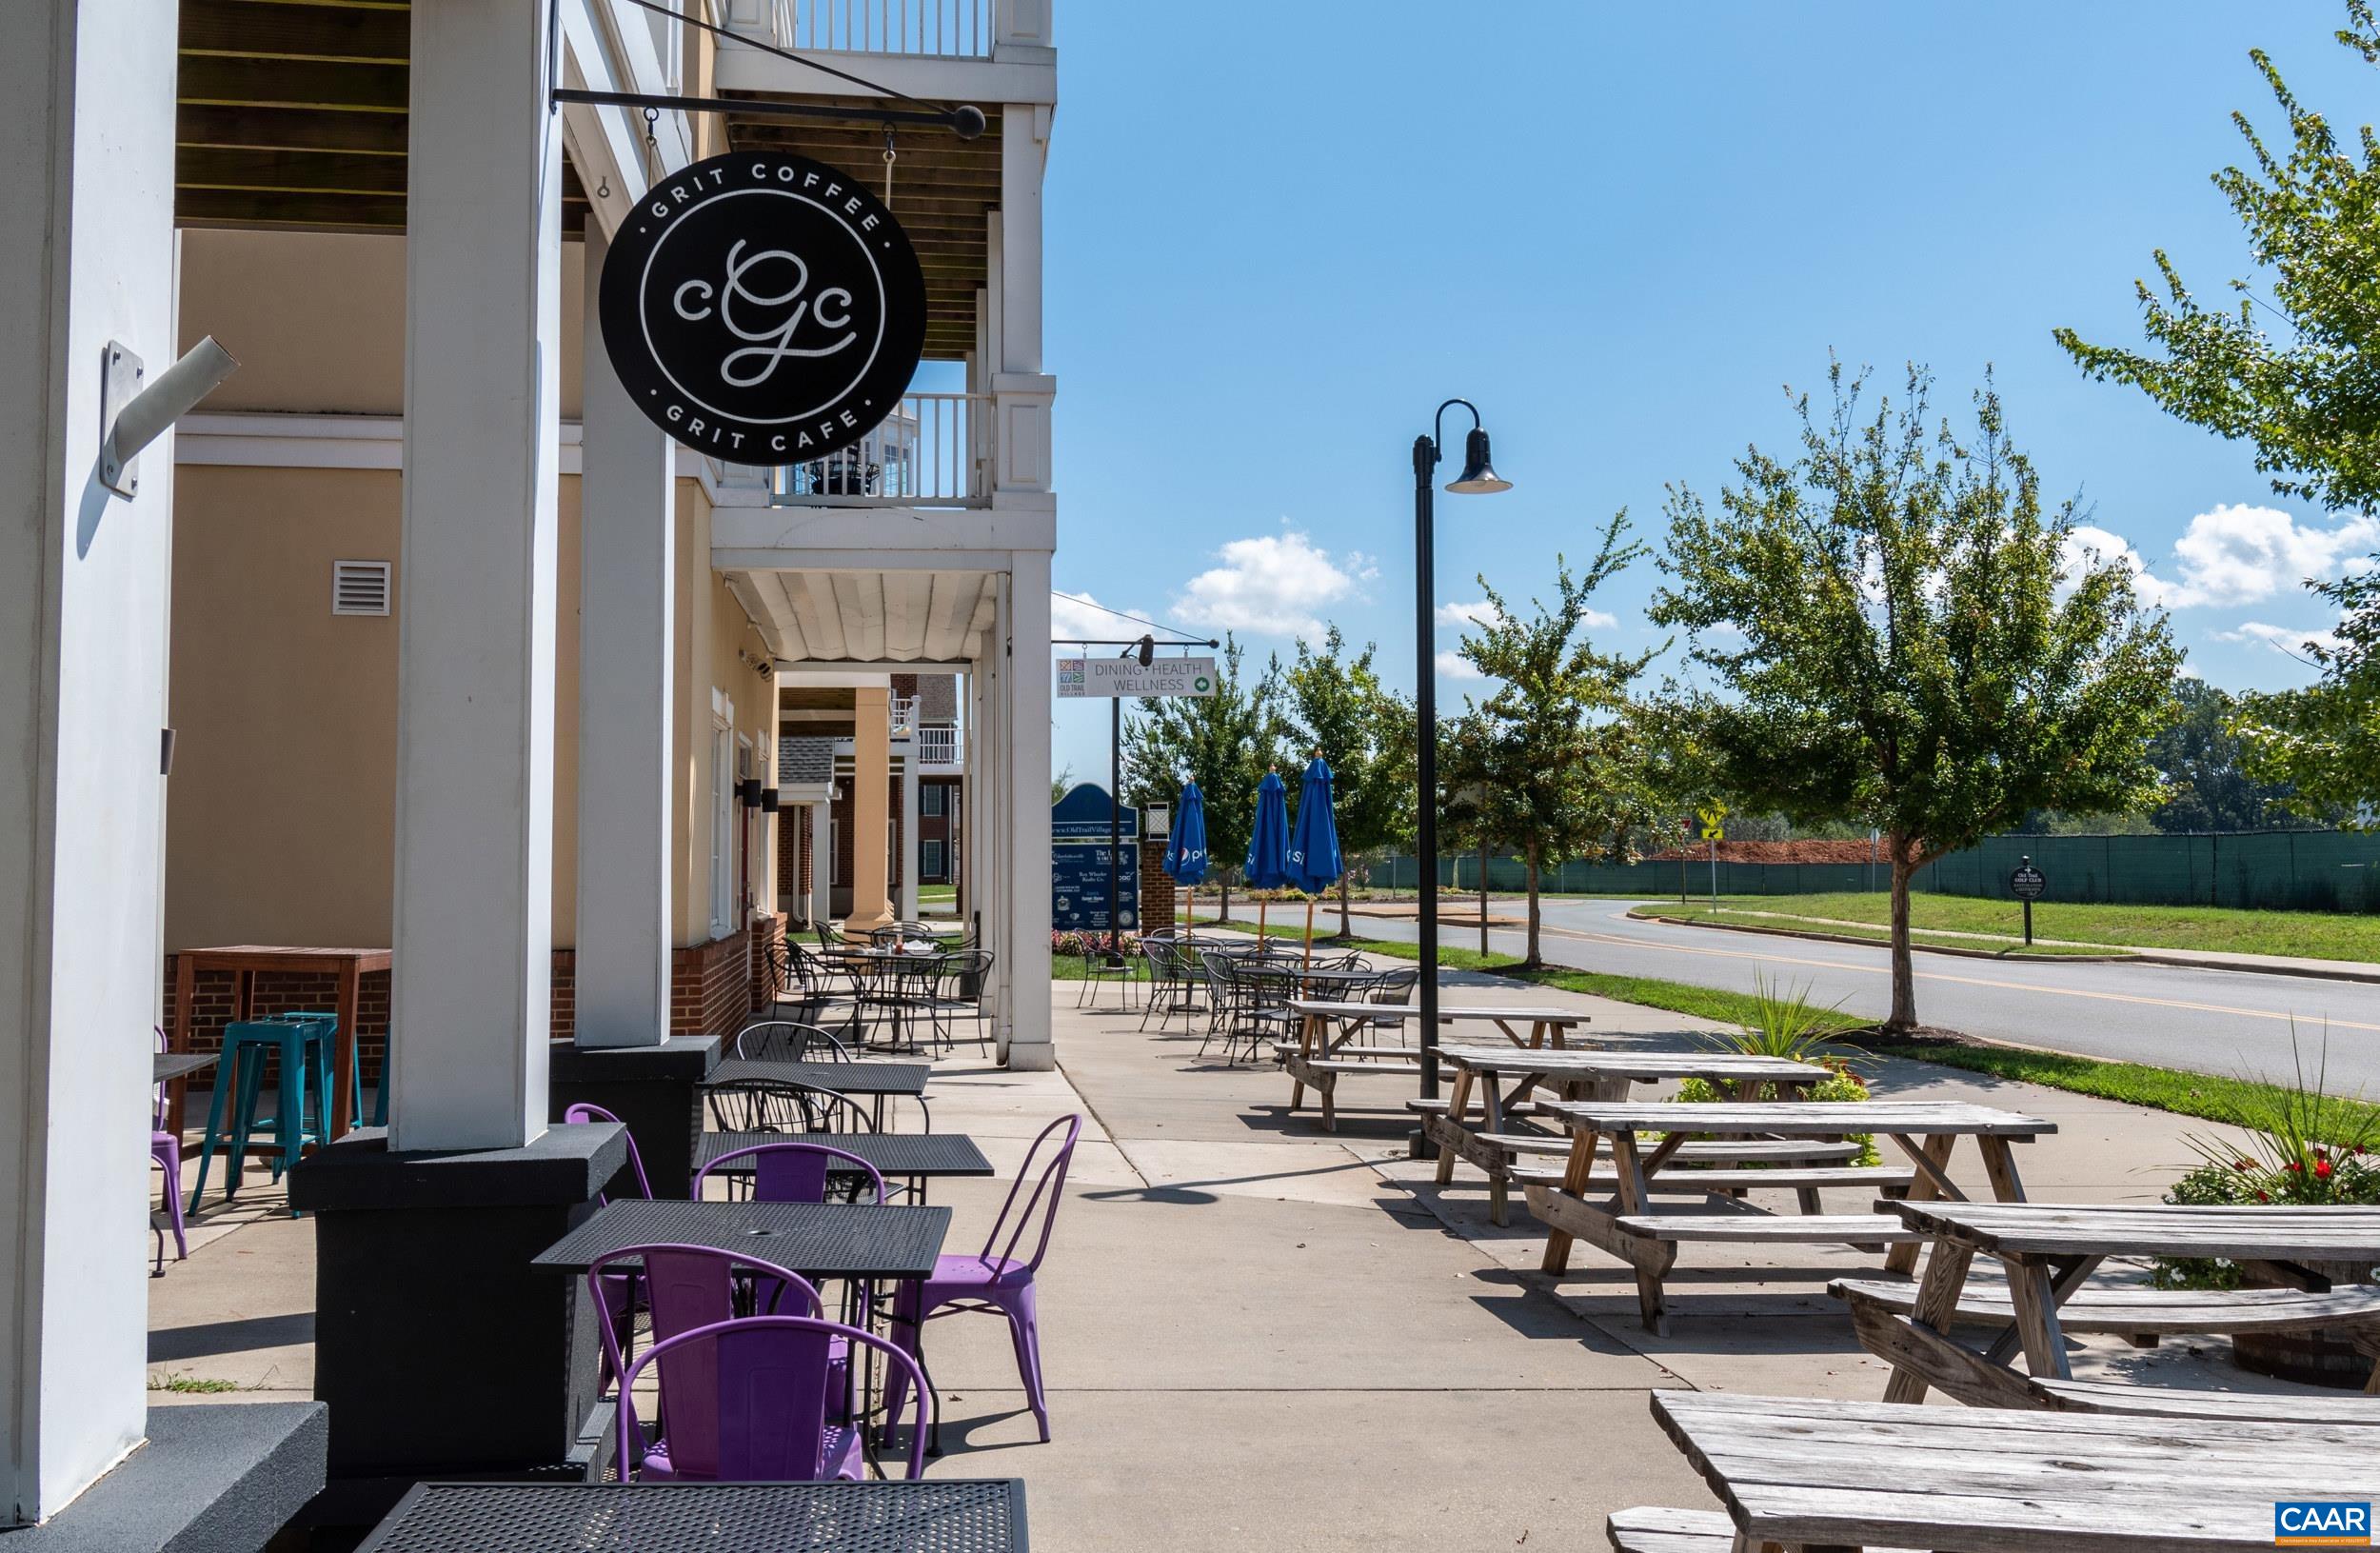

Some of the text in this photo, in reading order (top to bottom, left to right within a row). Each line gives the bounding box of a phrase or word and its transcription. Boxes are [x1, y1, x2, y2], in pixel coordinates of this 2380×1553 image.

[651, 163, 881, 231] GRIT COFFEE
[666, 404, 858, 451] GRIT CAFE
[1096, 663, 1202, 676] DINING HEALTH
[1113, 679, 1184, 691] WELLNESS
